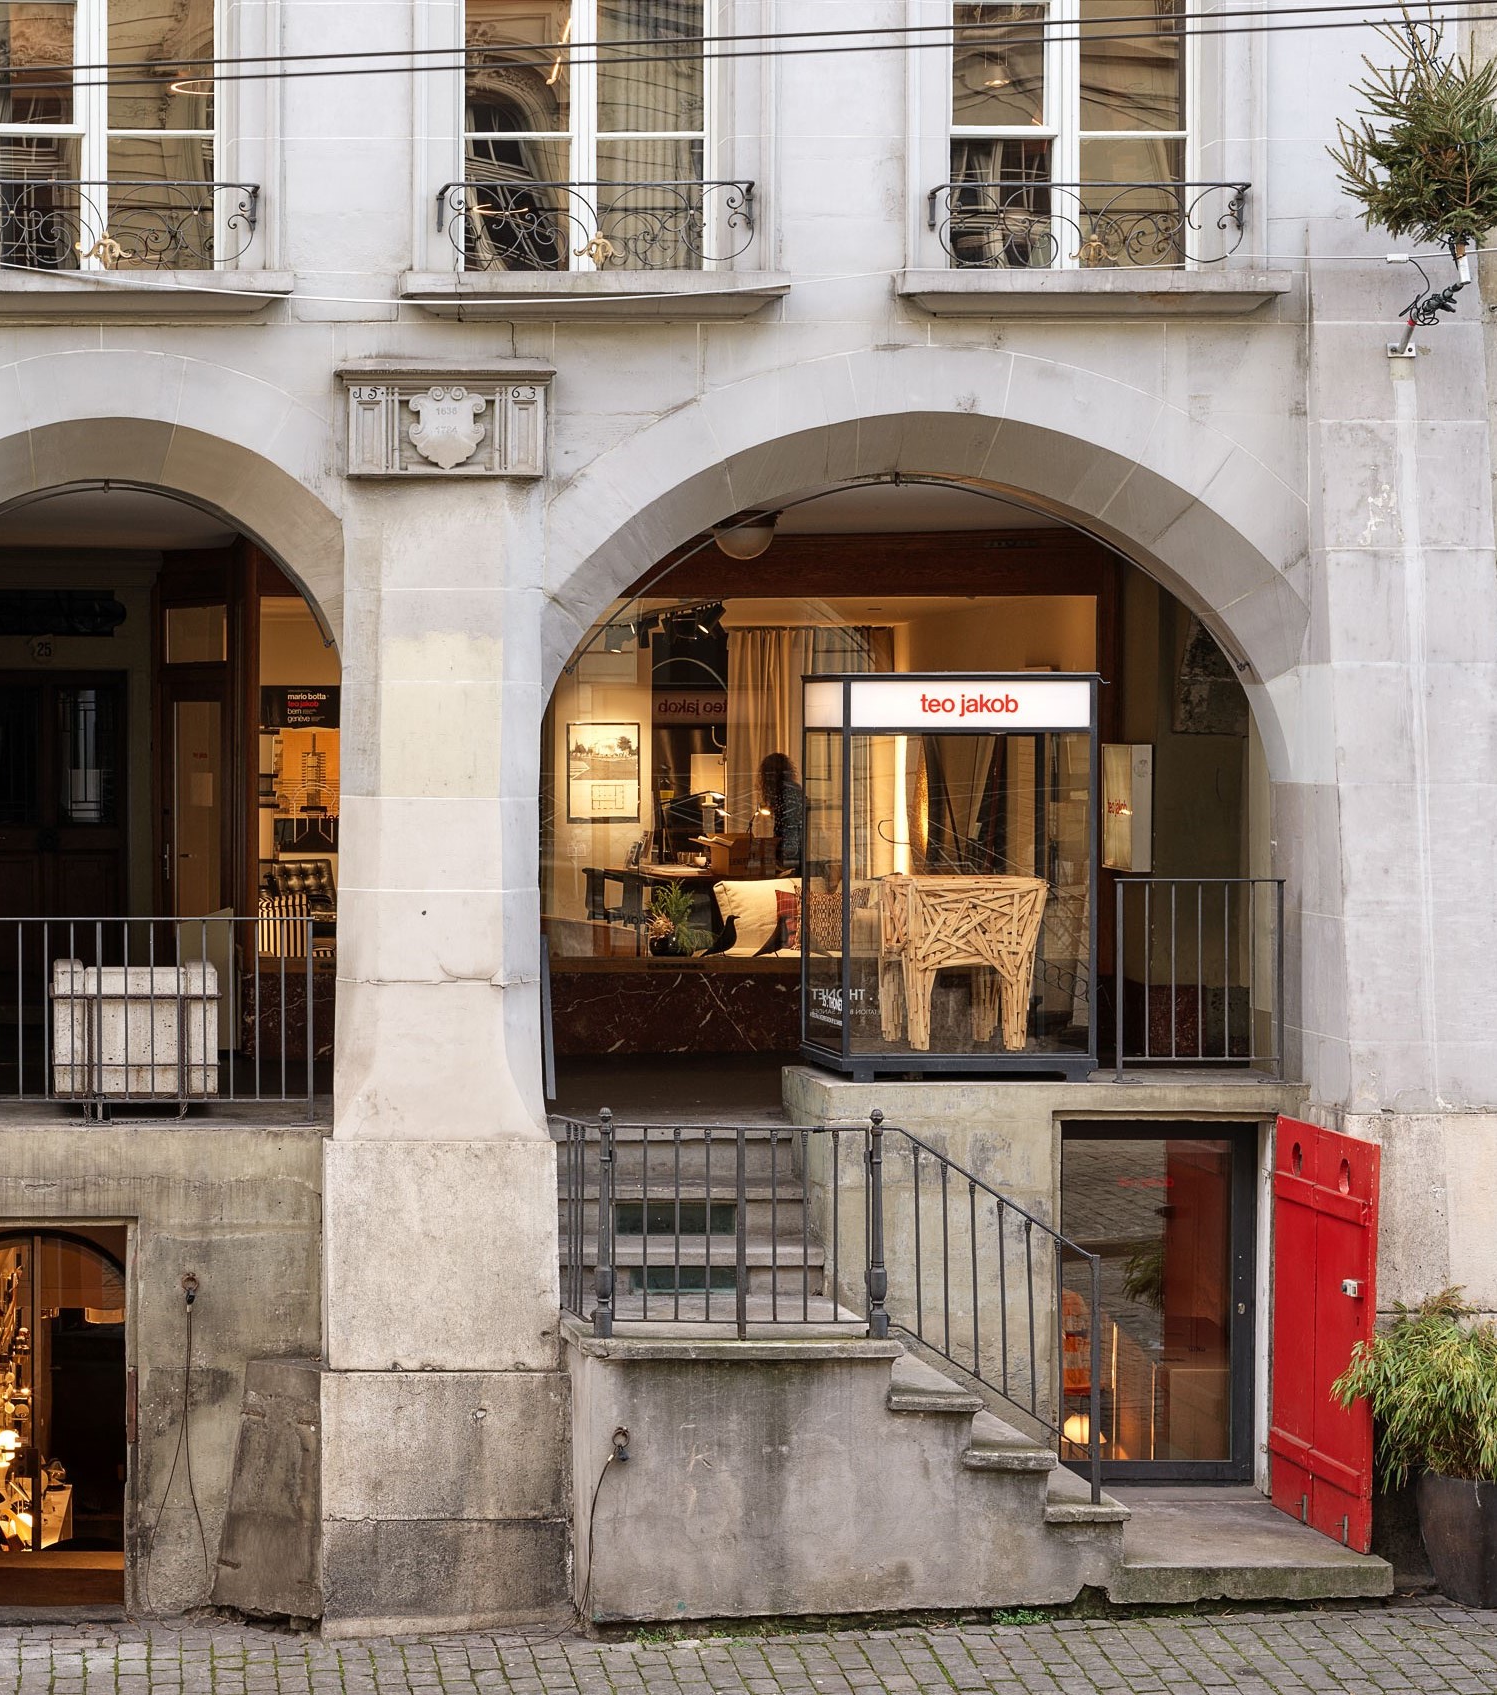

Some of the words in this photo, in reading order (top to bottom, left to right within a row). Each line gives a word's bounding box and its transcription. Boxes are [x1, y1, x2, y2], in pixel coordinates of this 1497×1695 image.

[37, 642, 52, 657] 25
[920, 694, 956, 713] teo
[959, 694, 1019, 717] jakob
